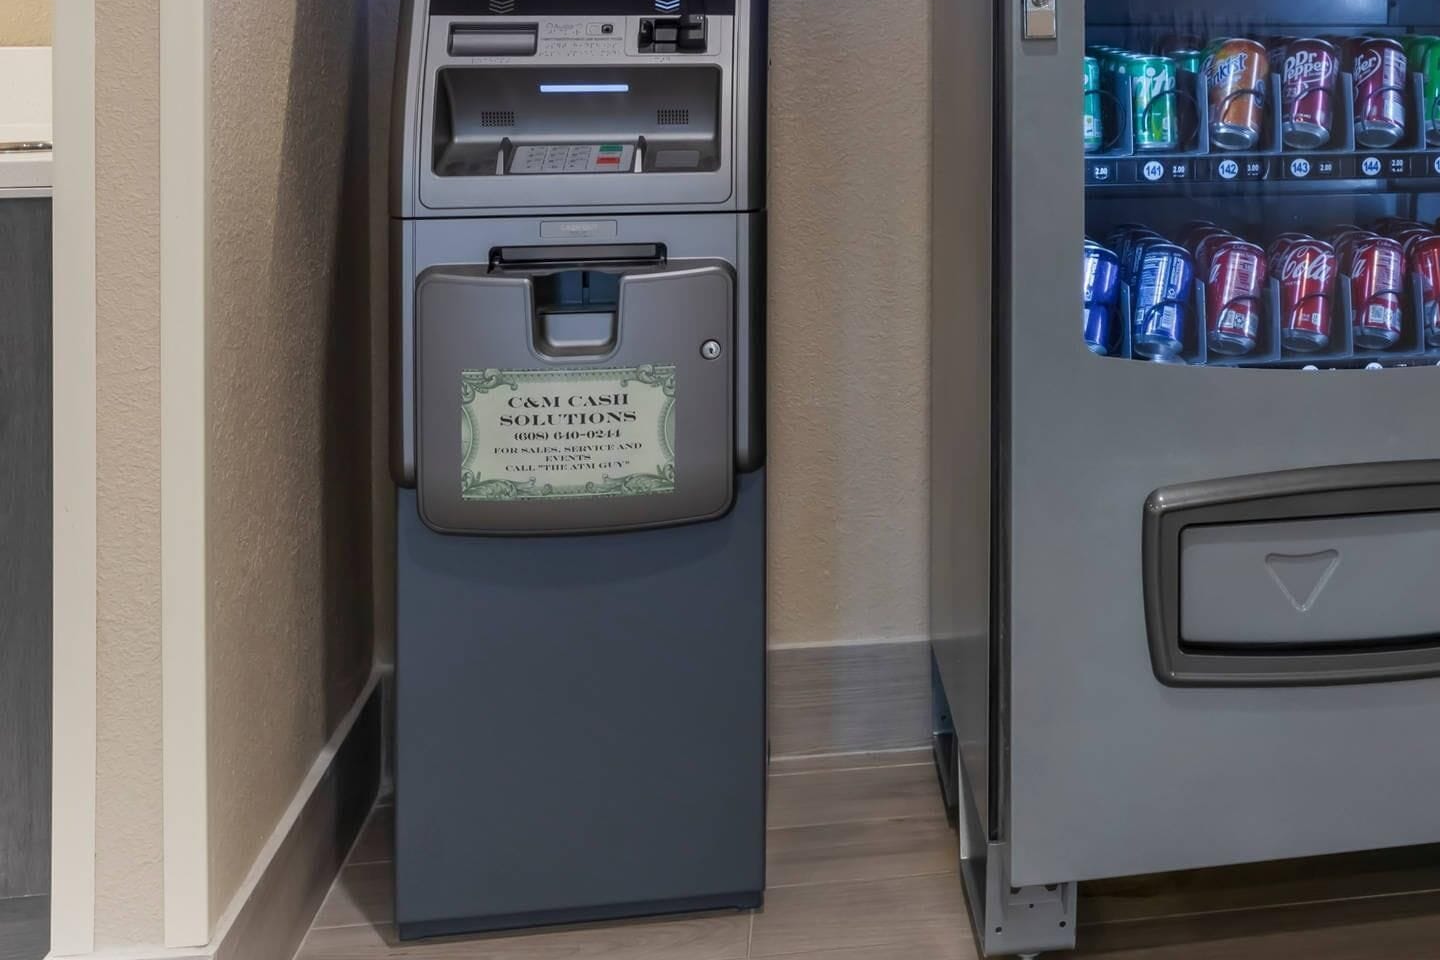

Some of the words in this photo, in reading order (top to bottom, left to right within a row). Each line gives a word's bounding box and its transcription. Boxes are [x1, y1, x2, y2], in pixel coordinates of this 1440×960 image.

[1296, 50, 1316, 65] Dr
[1284, 58, 1331, 82] Pepper
[1145, 165, 1162, 176] 141
[1220, 164, 1237, 175] 142
[1292, 162, 1309, 173] 143
[1363, 161, 1380, 172] 144
[507, 396, 560, 409] C&M
[568, 393, 629, 407] CASH
[500, 411, 637, 426] SOLUTIONS
[513, 431, 549, 442] (608)
[553, 429, 621, 441] 640-0244
[494, 447, 519, 455] FOR
[564, 444, 615, 452] SERVICE
[618, 442, 642, 450] AND
[545, 453, 592, 462] EVENTS
[569, 462, 596, 470] ATM
[599, 460, 631, 470] GUY"
